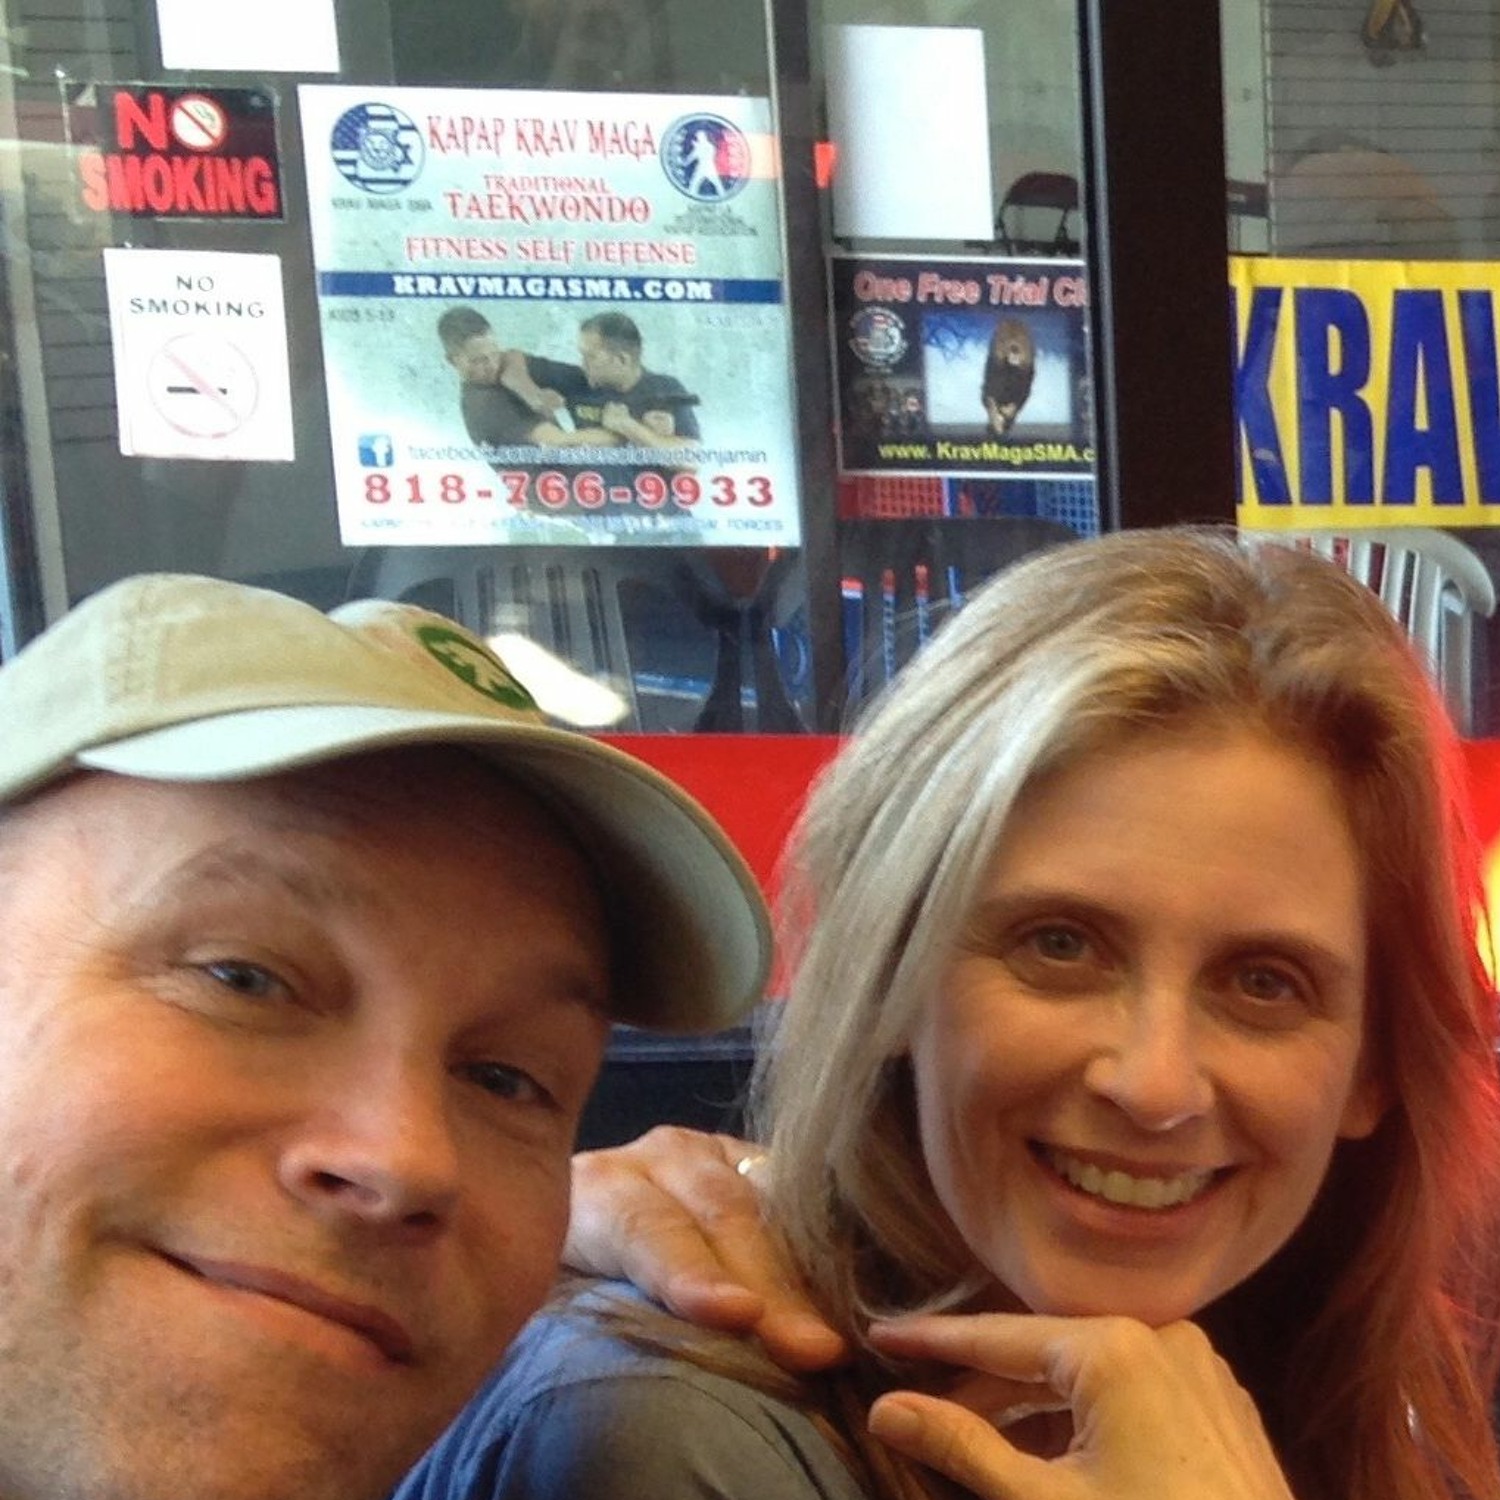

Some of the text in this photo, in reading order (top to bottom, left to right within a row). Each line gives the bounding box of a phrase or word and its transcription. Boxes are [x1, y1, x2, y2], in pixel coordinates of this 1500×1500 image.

[114, 91, 227, 151] NO
[427, 115, 658, 162] KAPAP KRAV MAGA
[80, 153, 278, 214] SMOKING
[484, 174, 611, 193] TRADITIONAL
[444, 192, 651, 225] TAEKWONDO
[406, 236, 697, 266] FITNESS SELF DEFENSE
[176, 274, 214, 292] NO
[392, 275, 714, 301] KRAVMAGASMA.COM
[853, 271, 912, 302] One
[916, 272, 982, 304] Free
[986, 274, 1048, 306] Trial
[129, 297, 265, 319] SMOKING
[937, 441, 1096, 464] KravMagaSMA.c
[364, 471, 775, 509] 818-766-9933
